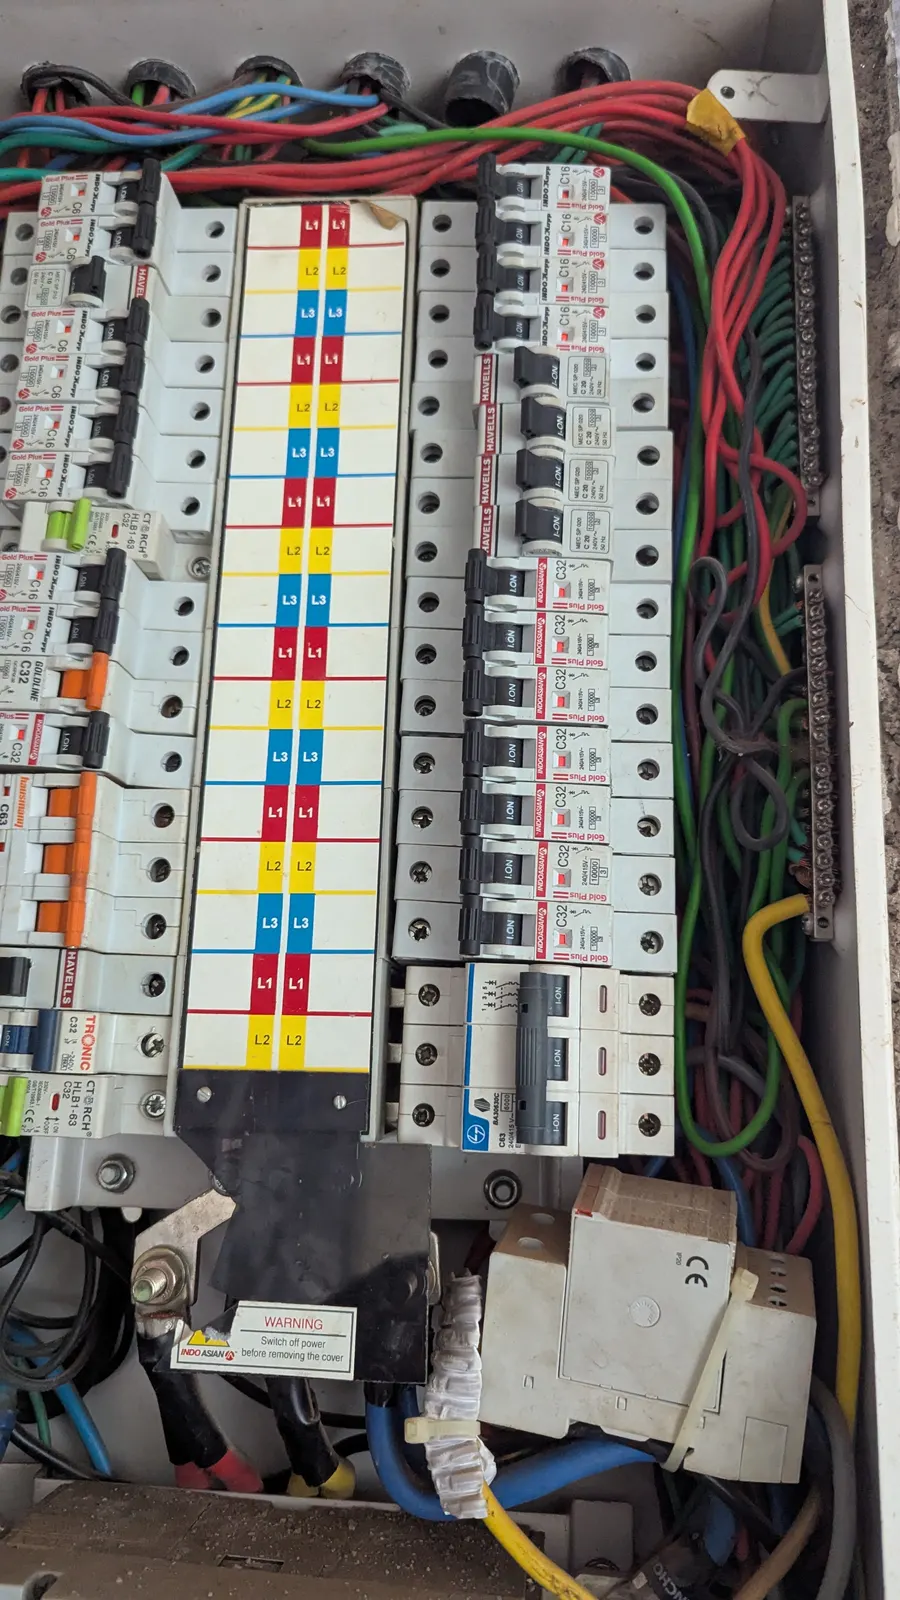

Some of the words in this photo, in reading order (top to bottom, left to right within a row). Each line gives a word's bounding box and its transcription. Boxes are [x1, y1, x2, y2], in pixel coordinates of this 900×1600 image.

[560, 166, 570, 185] C16
[71, 202, 82, 214] C6
[305, 220, 318, 230] L1
[332, 219, 345, 230] L1
[561, 214, 572, 232] C16
[66, 248, 77, 260] C6
[306, 267, 319, 276] L2
[333, 266, 346, 275] L2
[560, 259, 570, 278] C16
[136, 269, 147, 297] HAVEL
[301, 308, 315, 318] L3
[329, 308, 342, 318] L3
[560, 306, 570, 326] C16
[58, 340, 67, 352] C6
[297, 355, 310, 365] L1
[324, 355, 338, 365] L1
[482, 358, 491, 402] HAVELLS
[51, 385, 62, 399] C6
[297, 403, 311, 412] L2
[325, 402, 338, 411] L2
[488, 406, 496, 452] HAVELLS
[46, 430, 57, 448] C16
[292, 447, 306, 457] L3
[320, 446, 334, 457] L3
[482, 458, 490, 504] HAVELLS
[38, 478, 50, 498] C16
[287, 496, 301, 507] L1
[316, 496, 330, 507] L1
[122, 513, 130, 528] C32
[127, 513, 140, 550] HLB1-63
[287, 546, 302, 556] L2
[316, 546, 330, 556] L2
[556, 560, 567, 580] C32
[28, 580, 41, 600] C16
[283, 595, 297, 605] L3
[312, 594, 326, 605] L3
[554, 615, 566, 635] C32
[21, 632, 34, 652] C16
[278, 647, 292, 658] L1
[308, 647, 321, 658] L1
[18, 660, 32, 684] C32
[30, 660, 44, 702] GOLDLINE
[555, 669, 566, 690] C32
[537, 678, 545, 714] INDOASIAN
[276, 699, 291, 709] L2
[306, 699, 321, 709] L2
[556, 728, 567, 750] C32
[10, 742, 22, 763] C32
[273, 752, 288, 763] L3
[302, 751, 318, 763] L3
[538, 738, 546, 775] INDOASIAN
[555, 786, 566, 808] C32
[268, 807, 282, 818] L1
[298, 807, 313, 818] L1
[536, 795, 544, 834] INDOASIAN
[558, 845, 570, 867] C32
[266, 861, 281, 872] L2
[297, 861, 312, 872] L2
[538, 853, 546, 892] INDOASIAN
[570, 892, 587, 900] Plus
[556, 904, 568, 928] C32
[263, 917, 277, 929] L3
[293, 917, 308, 929] L3
[537, 914, 546, 953] INDOASIAN
[570, 953, 588, 962] Plus
[62, 952, 76, 1004] HAVELLS
[258, 977, 272, 989] L1
[289, 977, 303, 989] L1
[68, 1016, 78, 1034] C32
[80, 1014, 96, 1071] TRONIC
[255, 1034, 270, 1046] L2
[287, 1034, 302, 1046] L2
[62, 1080, 72, 1099] C32
[68, 1082, 82, 1126] HLB1-63
[264, 1316, 324, 1330] WARNING
[261, 1336, 288, 1348] Switch
[289, 1338, 300, 1348] off
[302, 1340, 326, 1350] power
[181, 1348, 200, 1357] INDO
[241, 1348, 266, 1358] before
[268, 1351, 305, 1362] removing
[306, 1352, 320, 1360] the
[320, 1354, 344, 1363] cover
